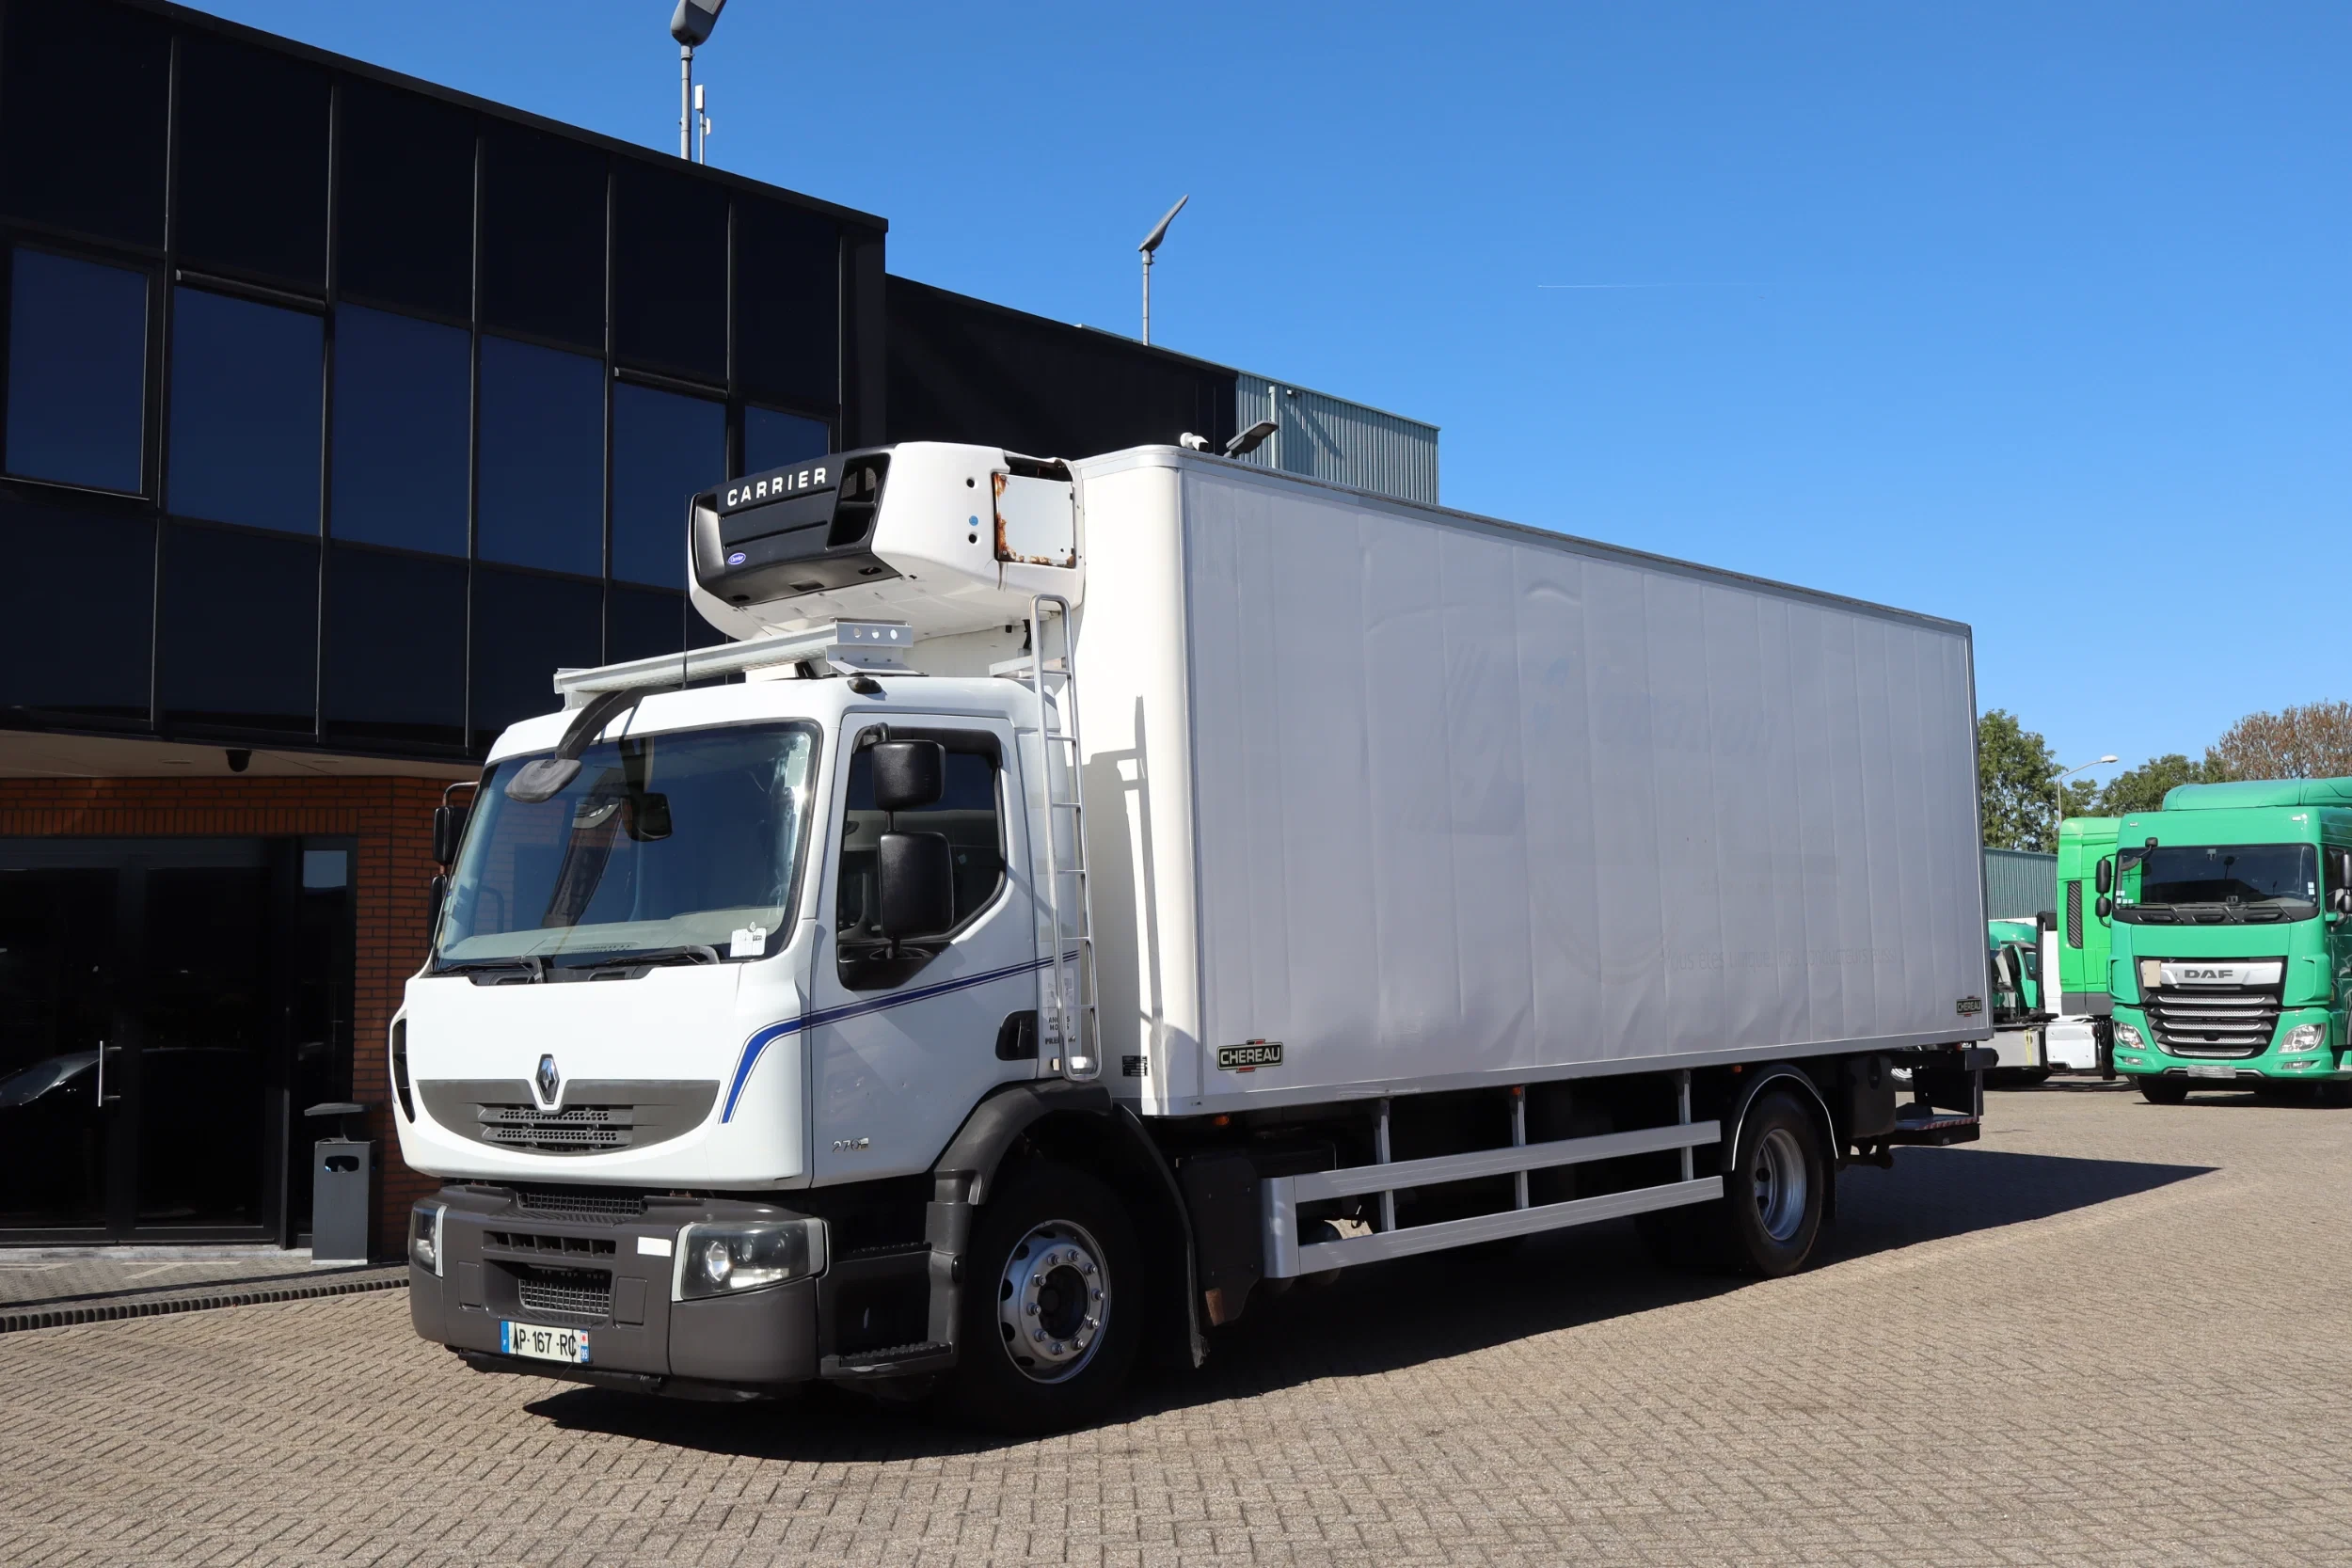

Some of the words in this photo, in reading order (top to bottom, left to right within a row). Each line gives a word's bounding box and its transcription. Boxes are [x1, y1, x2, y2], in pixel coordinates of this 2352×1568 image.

[727, 467, 826, 506] CARRIER
[2185, 970, 2233, 978] DAF
[1220, 1047, 1280, 1065] CHEREAU
